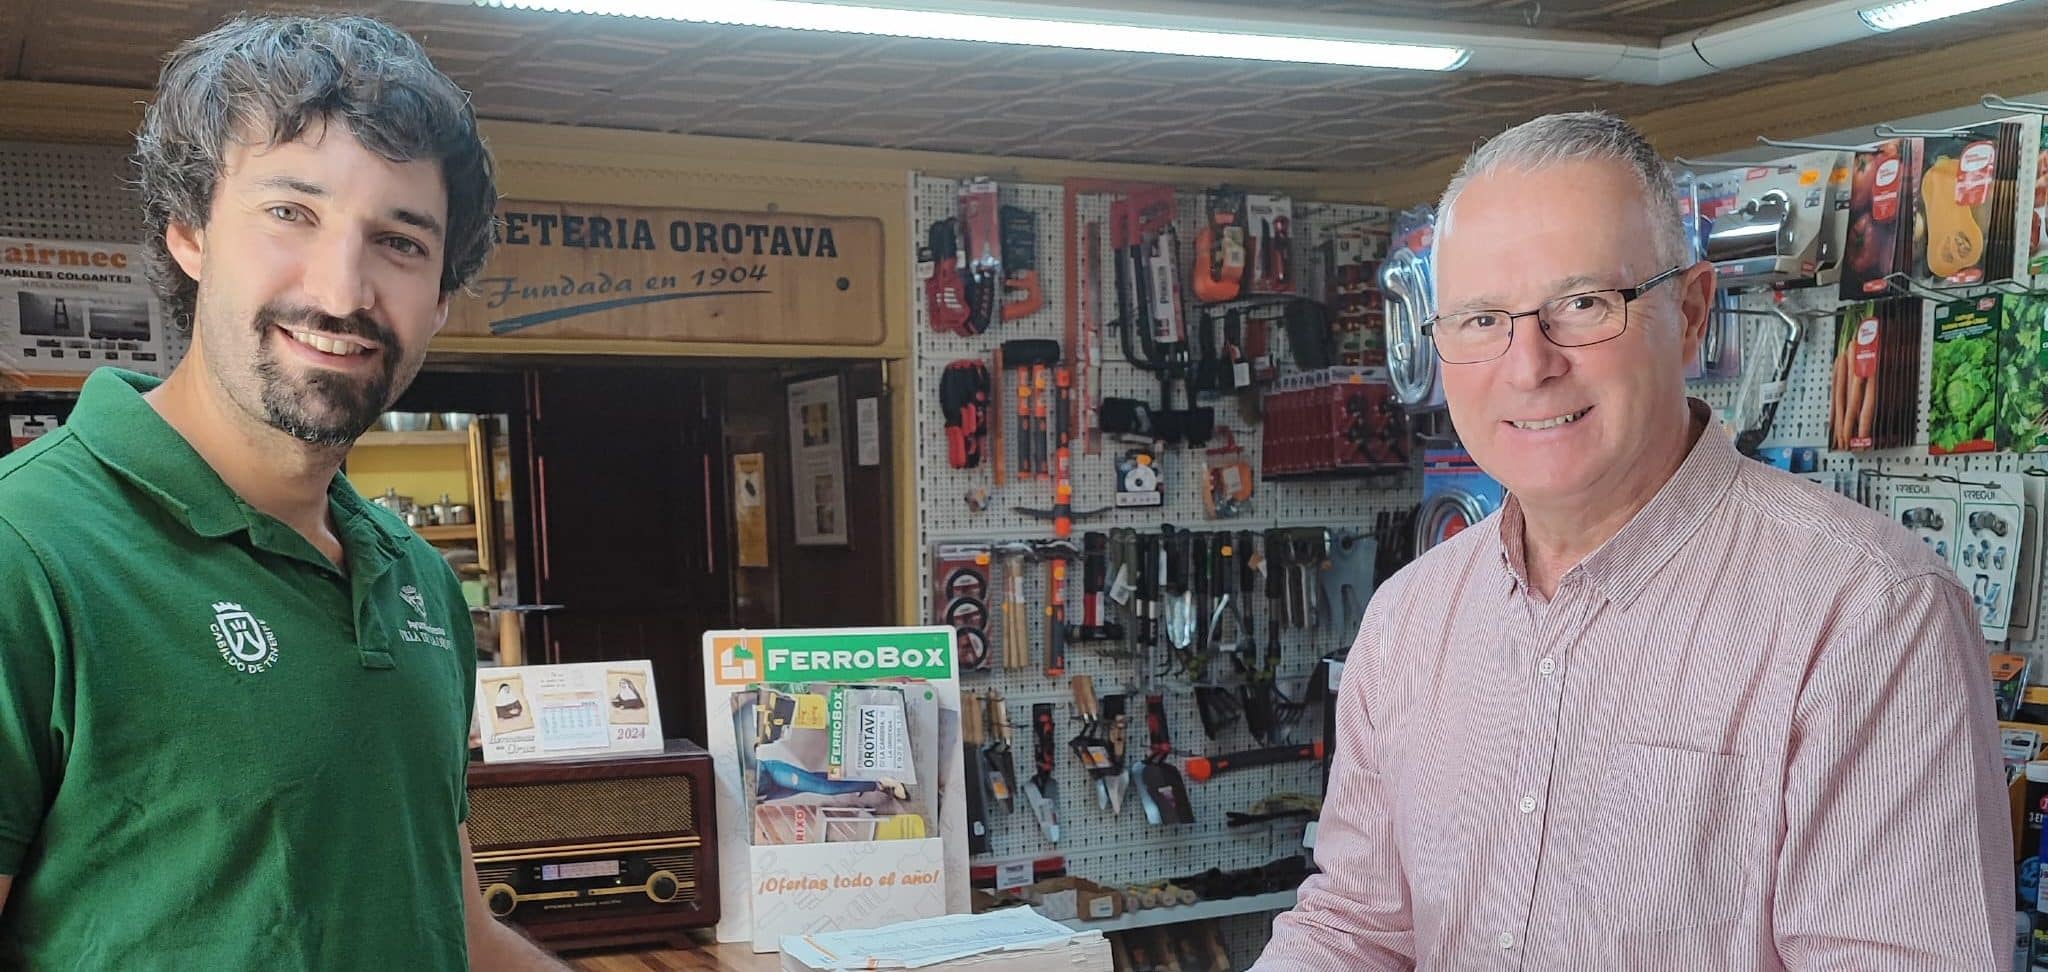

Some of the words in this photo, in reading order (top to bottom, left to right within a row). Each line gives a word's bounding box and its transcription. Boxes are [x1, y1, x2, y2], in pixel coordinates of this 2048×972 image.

[494, 211, 656, 251] ETERIA
[669, 220, 839, 258] OROTAVA
[4, 242, 128, 268] airmec
[56, 271, 132, 284] COLGANTES
[475, 276, 632, 309] Fundada
[645, 275, 677, 289] en
[693, 264, 768, 287] 1904
[210, 623, 246, 672] CABILDO
[247, 663, 265, 674] DE
[767, 646, 945, 671] FERROBOX
[617, 727, 646, 741] 2024
[830, 691, 843, 765] FERROBOX
[863, 709, 875, 768] OROTAVA
[795, 810, 805, 841] RIXO
[834, 872, 874, 889] todo
[879, 871, 896, 886] el
[902, 868, 940, 885] año!
